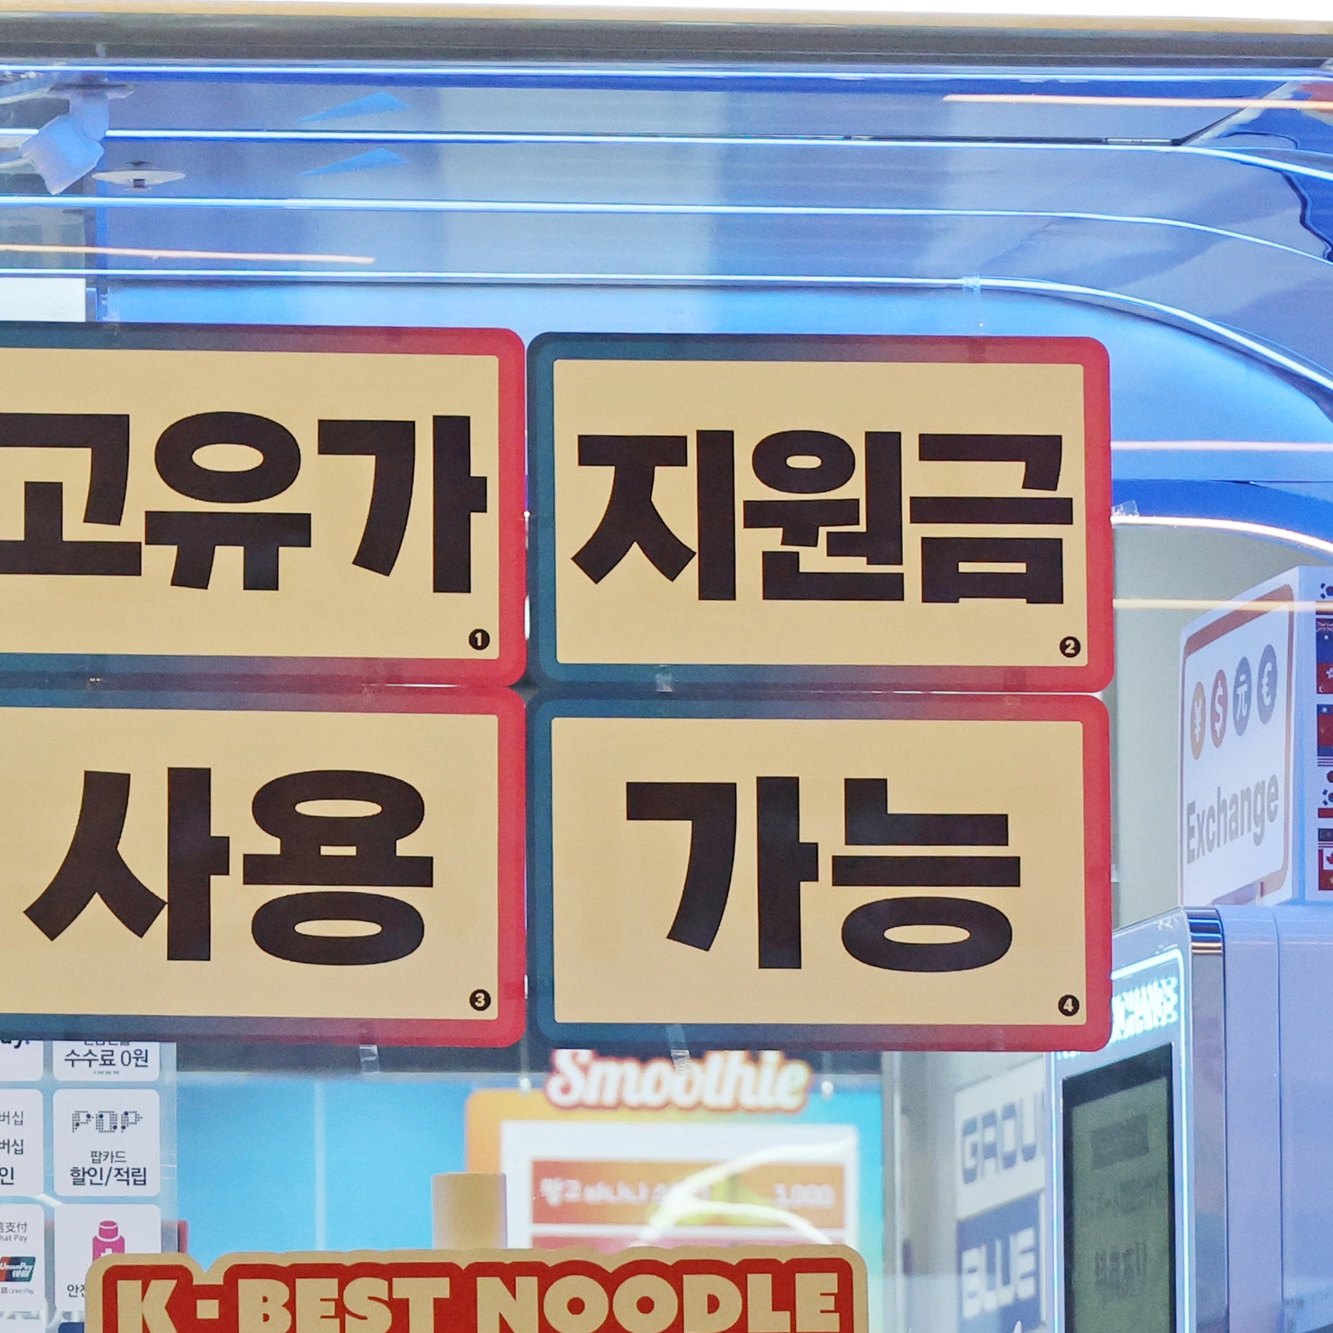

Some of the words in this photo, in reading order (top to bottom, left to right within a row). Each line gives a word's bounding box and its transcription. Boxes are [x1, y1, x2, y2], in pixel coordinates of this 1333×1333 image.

[571, 428, 1074, 605] 지원금
[1186, 773, 1279, 865] Exchange
[23, 767, 434, 967] 사용
[626, 775, 1021, 973] 가능
[64, 1049, 116, 1068] 수수료
[120, 1049, 149, 1068] 0원
[549, 1049, 809, 1111] Smoothie
[70, 1167, 147, 1187] 할인/적립
[91, 1150, 127, 1164] 팝카드
[14, 1234, 28, 1243] Pay
[961, 1226, 1037, 1320] BLUE
